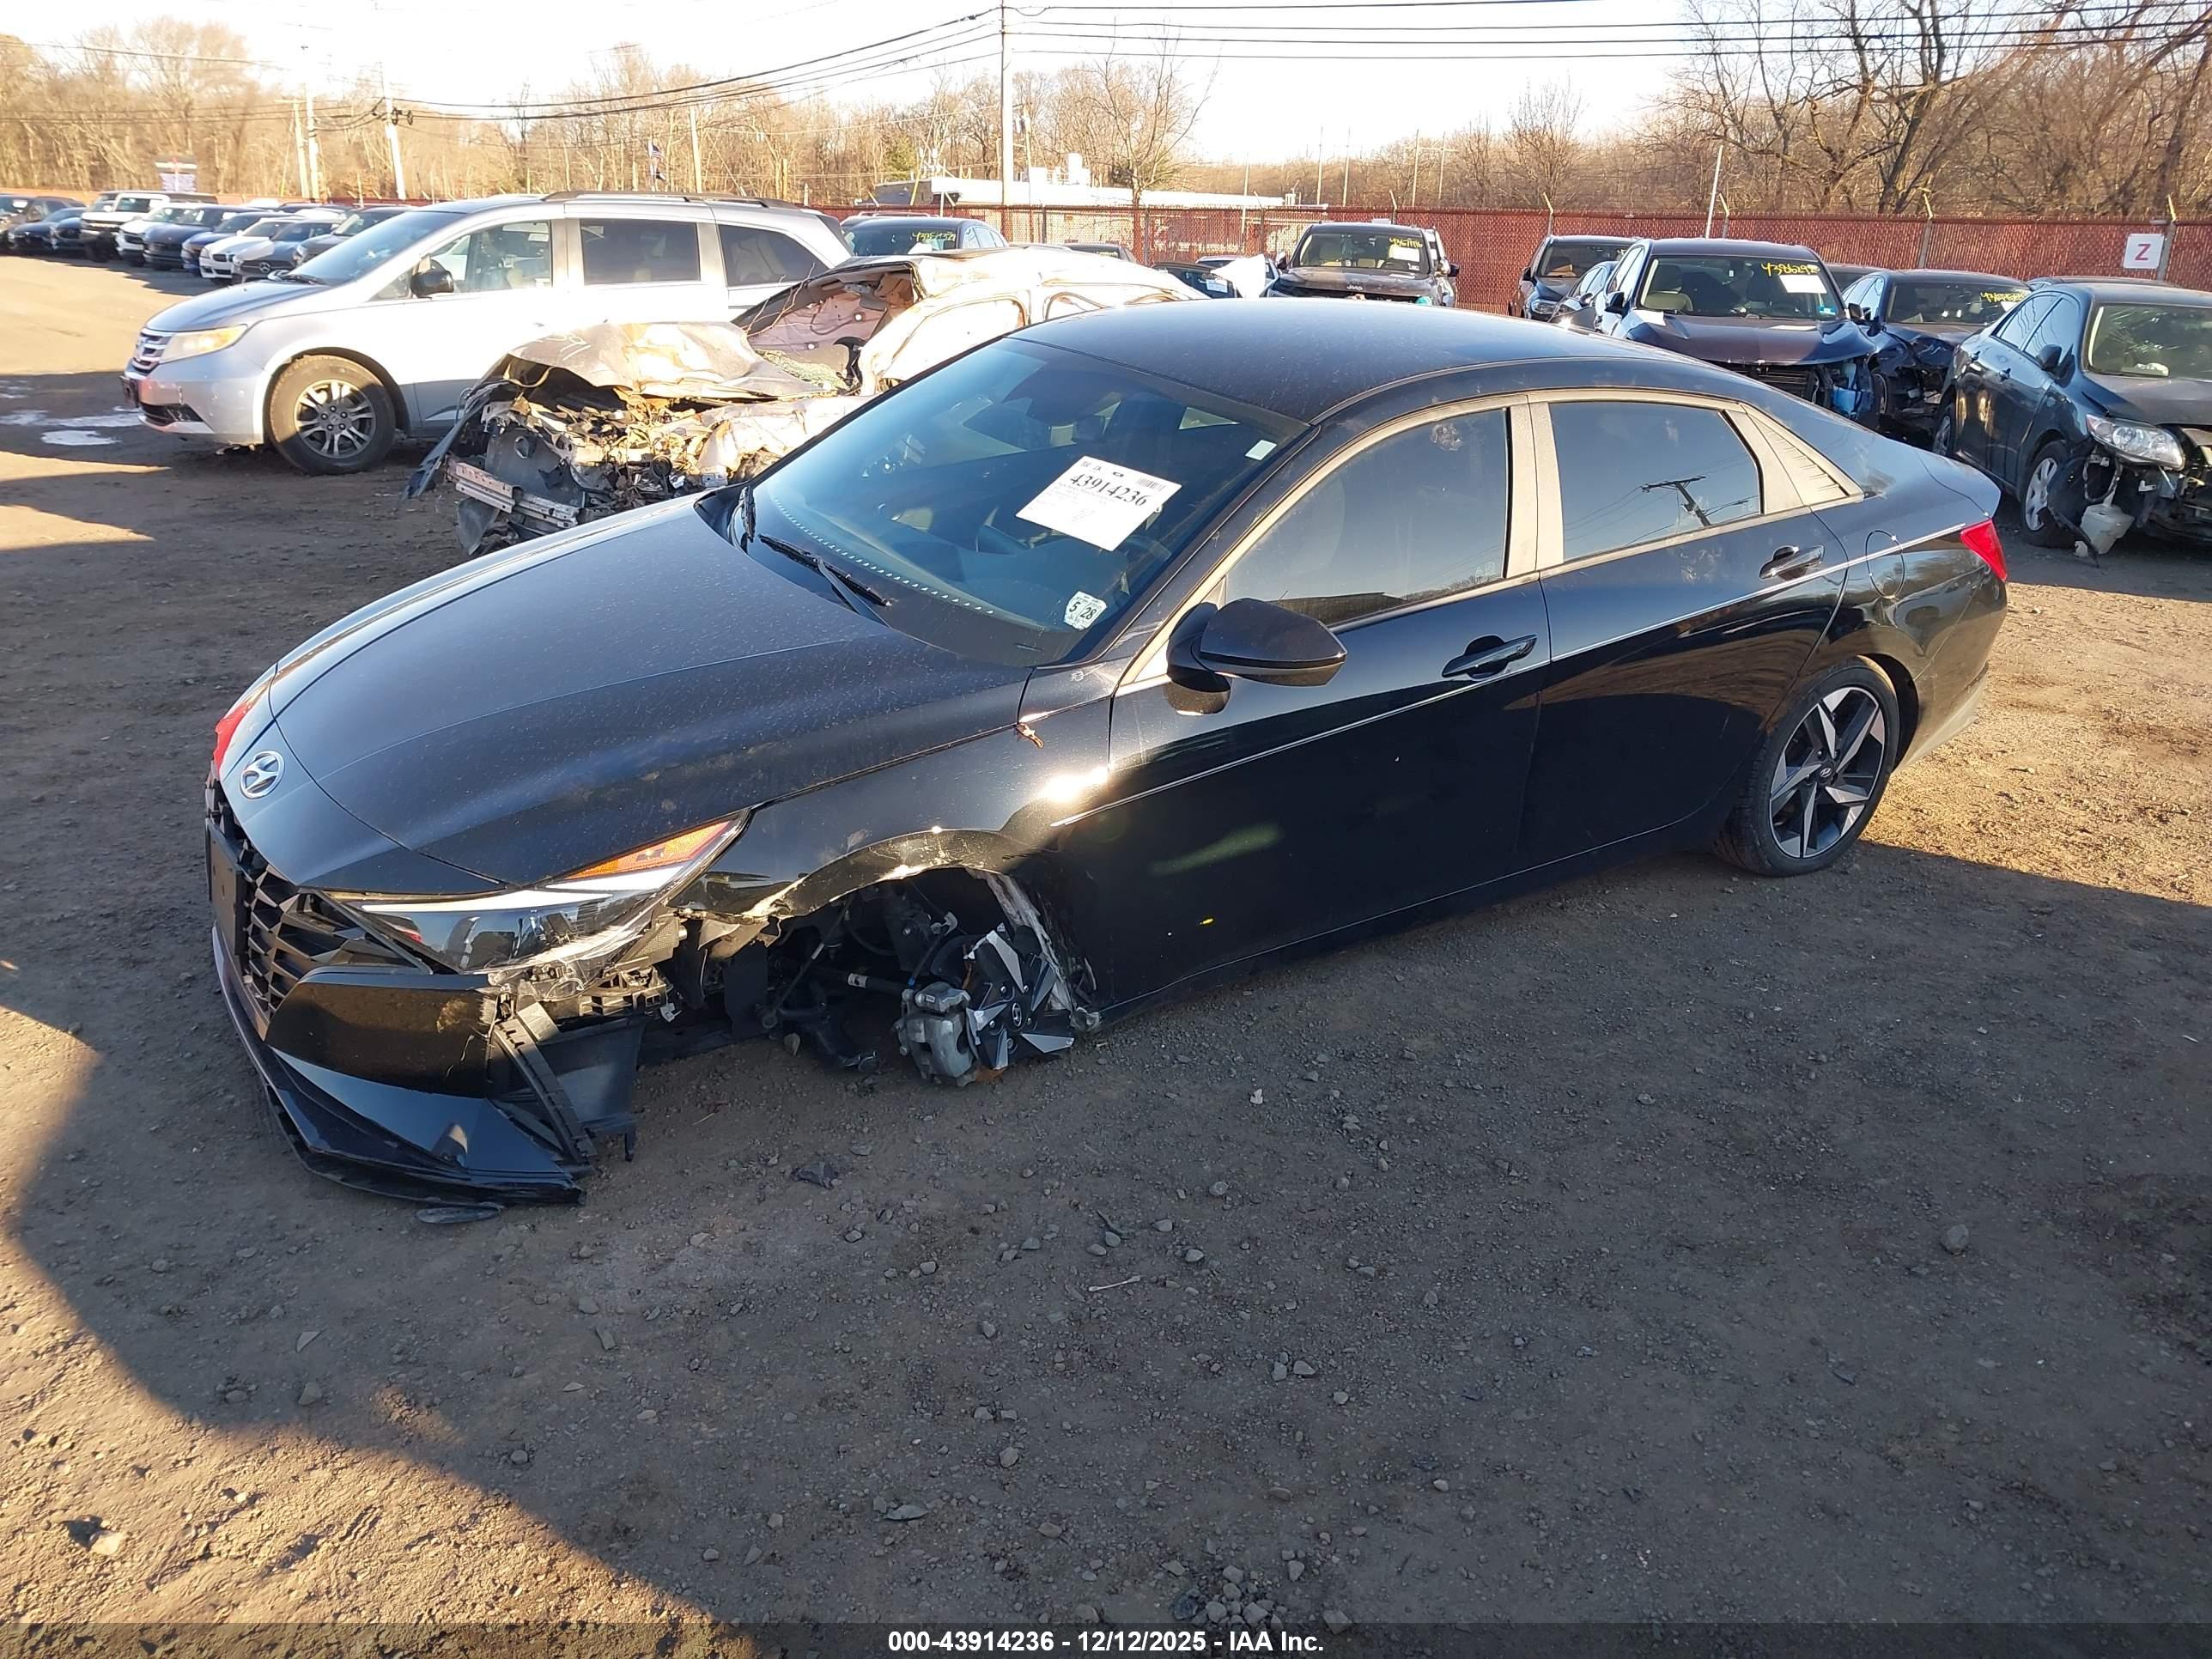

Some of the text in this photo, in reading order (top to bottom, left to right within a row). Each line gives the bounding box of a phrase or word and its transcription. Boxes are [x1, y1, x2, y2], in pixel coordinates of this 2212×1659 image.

[2135, 243, 2151, 261] Z
[1070, 473, 1152, 507] 43914236
[1069, 601, 1097, 620] 5 28
